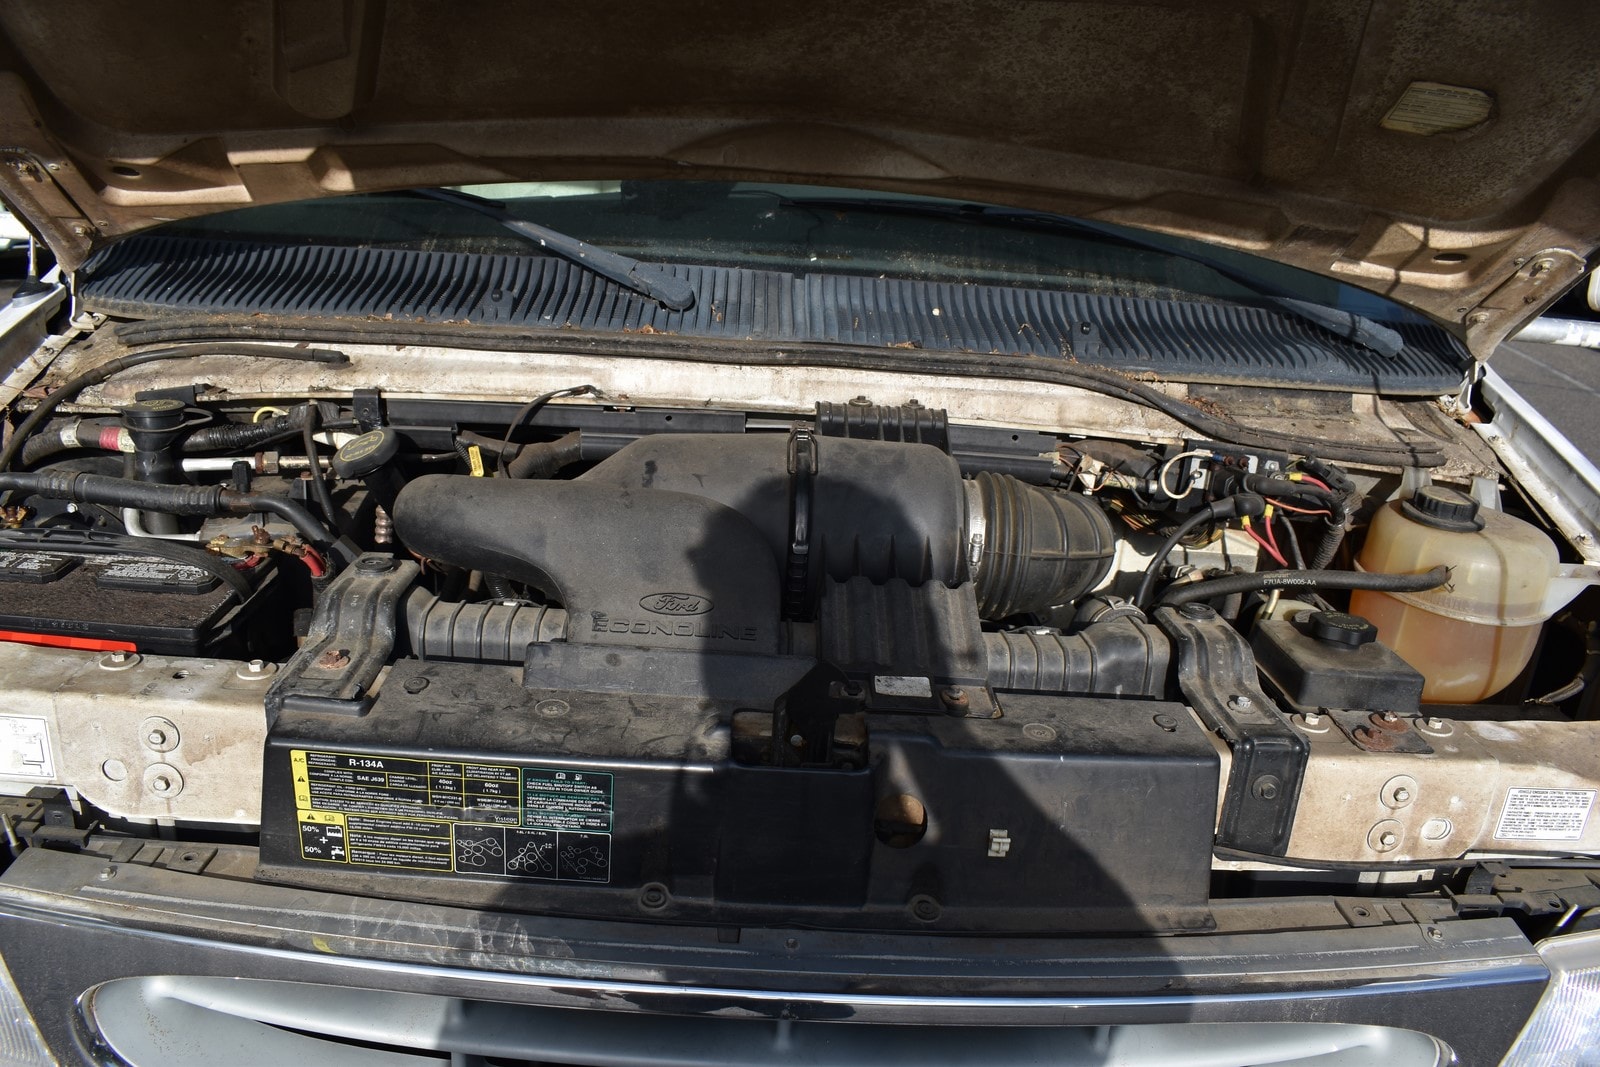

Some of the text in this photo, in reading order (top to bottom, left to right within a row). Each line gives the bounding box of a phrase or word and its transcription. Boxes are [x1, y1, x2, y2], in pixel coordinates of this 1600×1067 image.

[653, 595, 700, 612] Ford
[592, 617, 757, 641] ECONOLINE
[349, 758, 384, 768] R-134A
